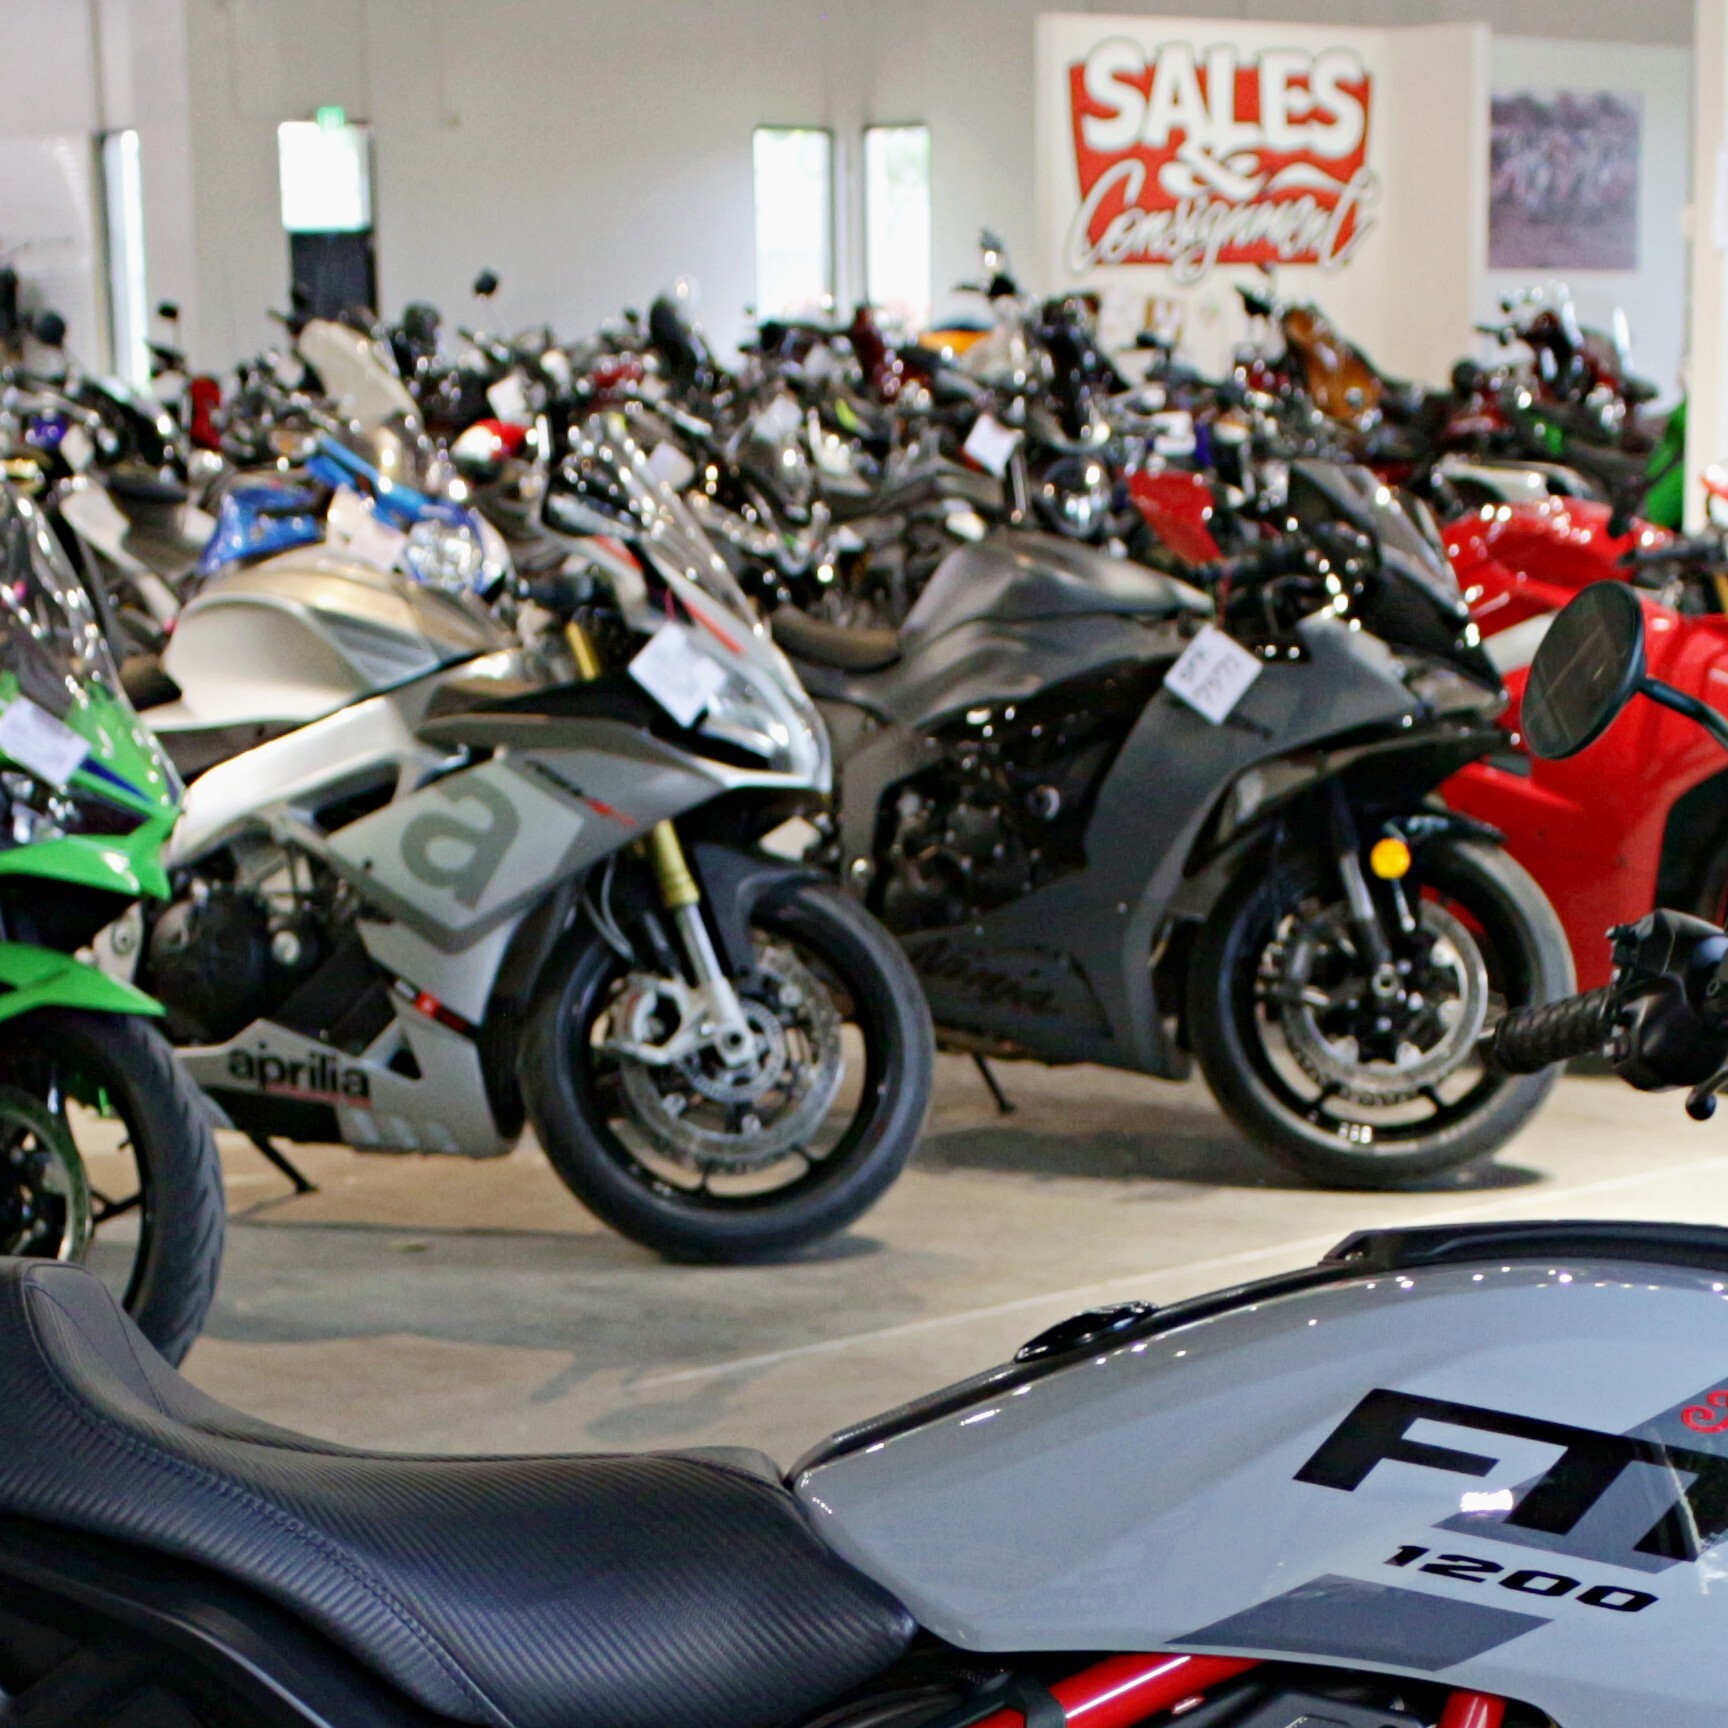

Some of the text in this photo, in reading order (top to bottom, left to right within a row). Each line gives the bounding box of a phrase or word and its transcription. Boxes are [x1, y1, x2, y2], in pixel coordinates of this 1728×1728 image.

[1083, 36, 1367, 158] SALES
[1158, 143, 1266, 201] &
[1066, 158, 1383, 285] Consignment
[228, 1040, 371, 1098] aprilia
[1383, 1544, 1660, 1613] 1200
